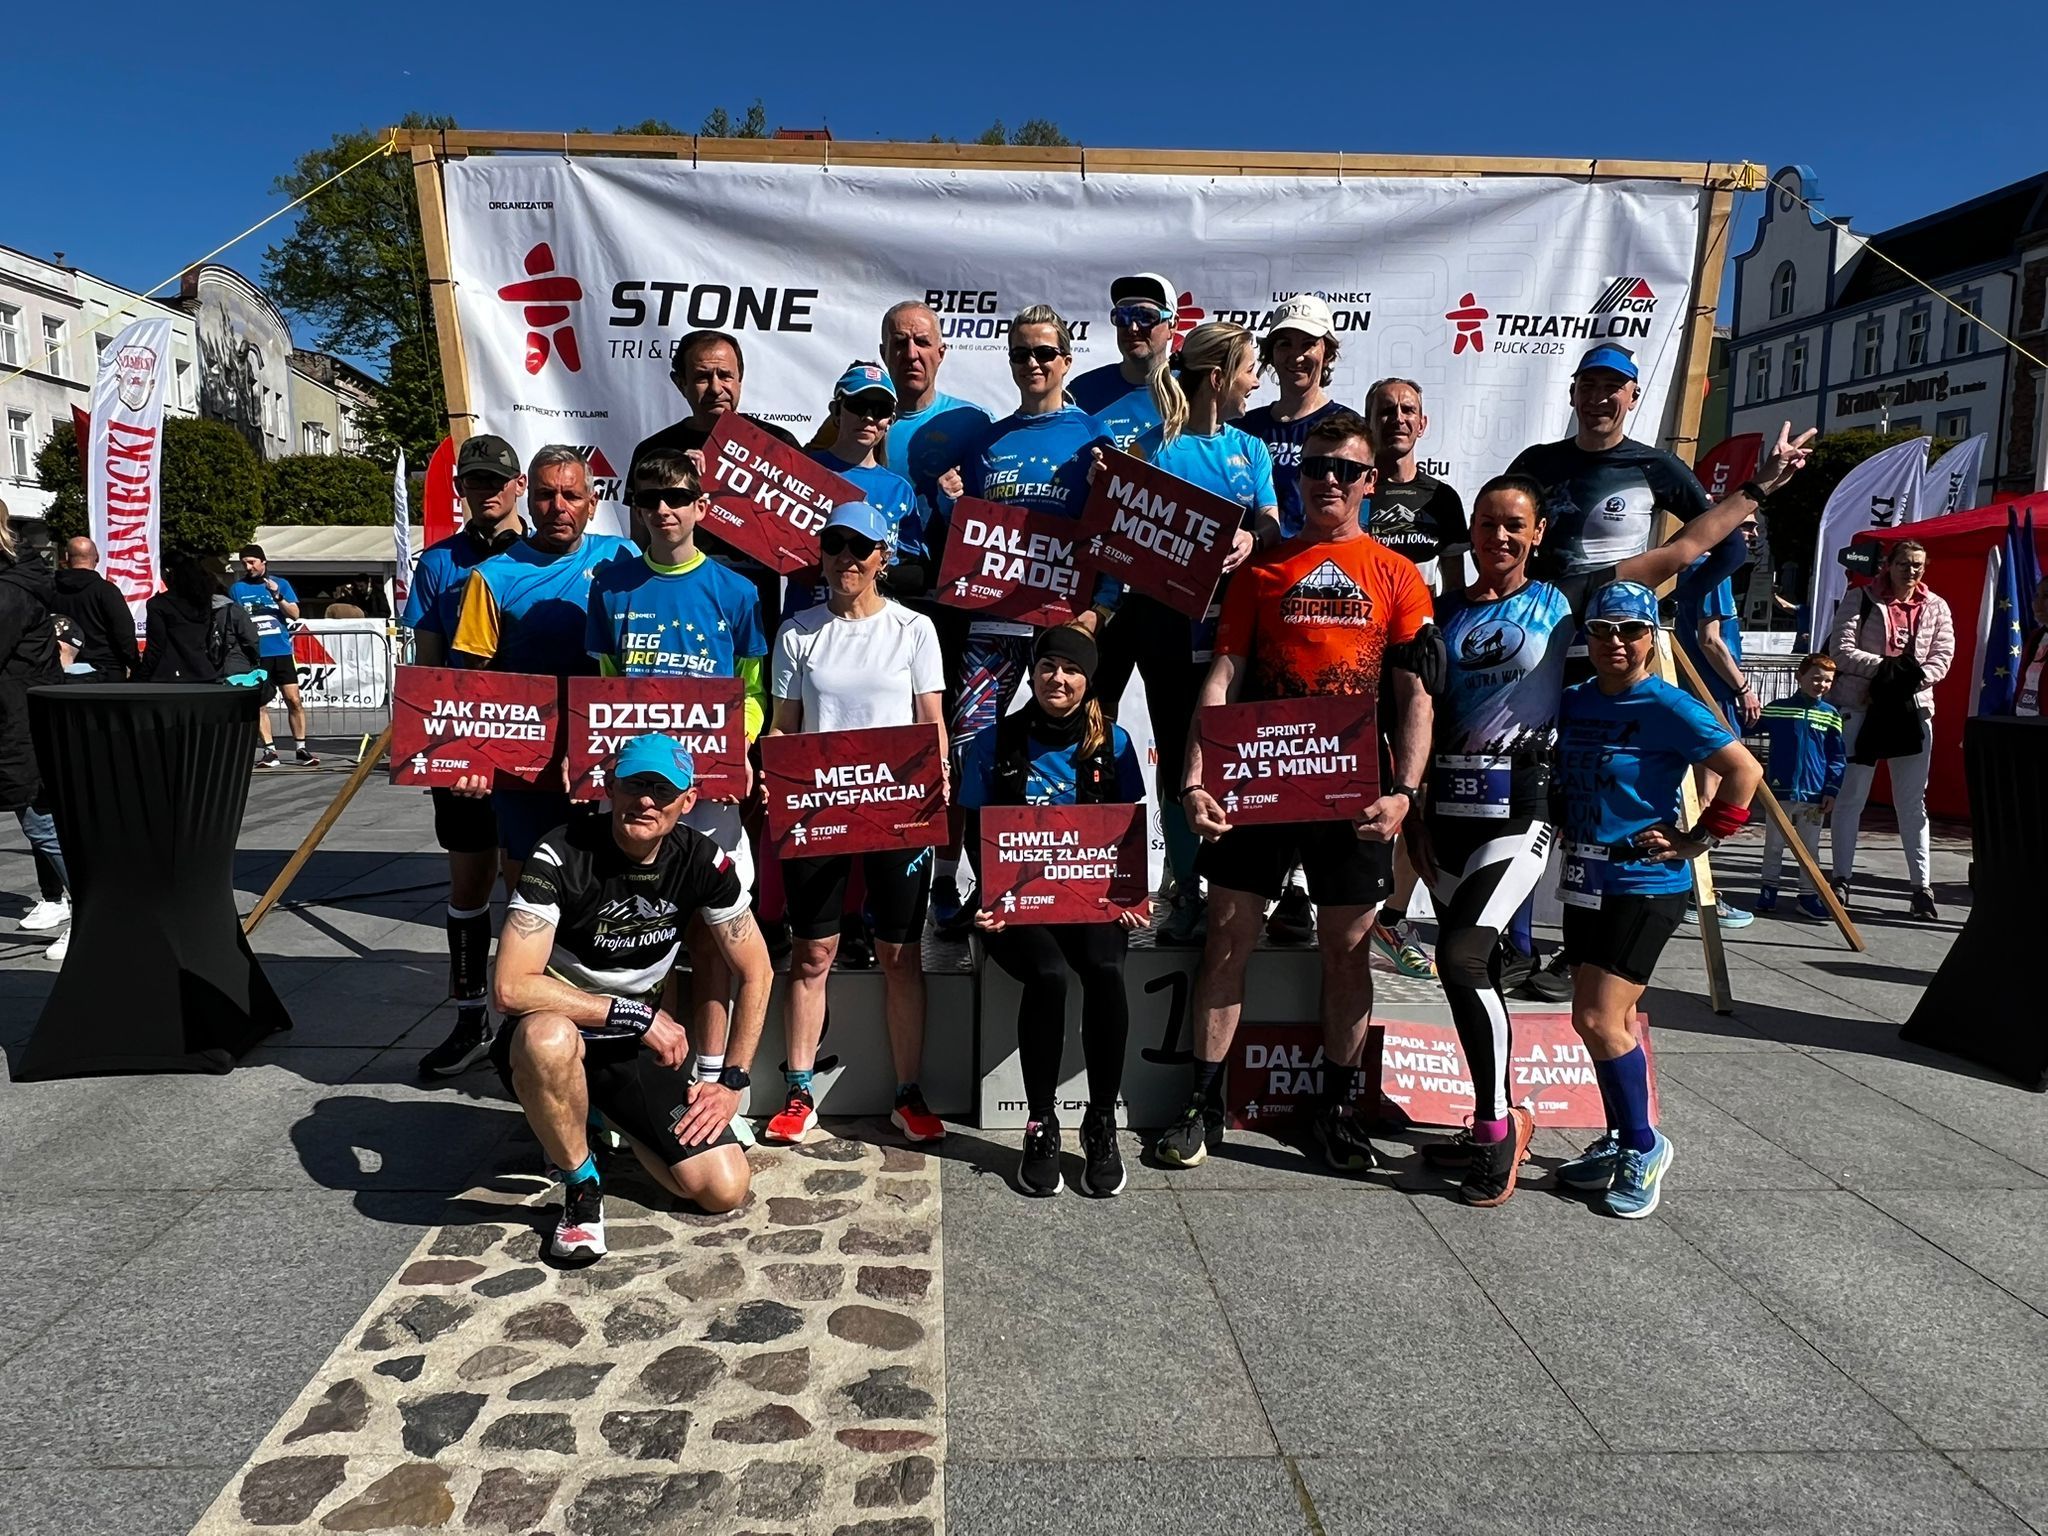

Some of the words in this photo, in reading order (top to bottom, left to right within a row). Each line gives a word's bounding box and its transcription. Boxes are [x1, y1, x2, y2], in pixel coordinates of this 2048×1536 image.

[489, 201, 554, 210] ORGANIZATOR
[609, 281, 819, 332] STONE
[925, 289, 997, 314] BIEG
[1619, 298, 1658, 314] PGK
[939, 318, 1090, 341] UROPKI
[1213, 310, 1371, 331] TRIAON
[1496, 314, 1650, 339] TRIATHLON
[608, 339, 642, 358] TRI
[648, 340, 663, 358] &
[1493, 341, 1531, 355] PUCK
[1533, 342, 1565, 355] 2025
[563, 410, 609, 419] TYTULARNI
[763, 412, 812, 422] ZAWODÓW
[723, 439, 750, 462] BO
[749, 457, 784, 483] JAK
[783, 476, 815, 501] NIE
[813, 494, 834, 514] JA
[984, 469, 1020, 489] BIEG
[597, 479, 622, 501] GK
[714, 456, 752, 494] TO
[754, 482, 827, 536] KTO?
[711, 504, 744, 527] STONE
[1107, 475, 1177, 526] MAM
[1185, 508, 1220, 553] TĘ
[963, 519, 1074, 566] DAŁEM
[1111, 508, 1195, 567] MOC!!!
[1104, 545, 1133, 565] STONE
[981, 551, 1080, 600] RADĘ!
[971, 584, 1003, 598] STONE
[1281, 599, 1373, 621] SPICHLERZ
[431, 700, 474, 718] JAK
[480, 702, 541, 722] RYBA
[588, 703, 725, 729] DZISIAJ
[423, 718, 447, 736] W
[452, 720, 547, 741] WODZIE!
[1257, 723, 1316, 738] SPRINT?
[588, 731, 727, 754] ŻYKA!
[1237, 736, 1340, 759] WRACAM
[431, 759, 470, 769] STONE
[1223, 763, 1252, 780] ZA
[1258, 761, 1271, 778] 5
[1278, 755, 1357, 776] MINUT!
[814, 762, 895, 788] MEGA
[787, 784, 925, 810] SATYSFAKCJA!
[1243, 794, 1279, 805] STONE
[811, 824, 847, 837] STONE
[998, 831, 1079, 847] CHWILA!
[999, 849, 1053, 865] MUSZĘ
[1056, 844, 1118, 861] ZŁAPAĆ
[1044, 863, 1131, 880] ODDECH...
[1020, 895, 1055, 905] STONE
[1383, 1035, 1428, 1050] EPADŁ
[1431, 1040, 1456, 1053] JAK
[1552, 1044, 1592, 1063] JUT
[1245, 1044, 1324, 1069] DAŁ
[1382, 1049, 1460, 1076] AMIEŃ
[1395, 1073, 1415, 1089] W
[1262, 1104, 1294, 1113] STONE
[1538, 1102, 1568, 1110] STONE
